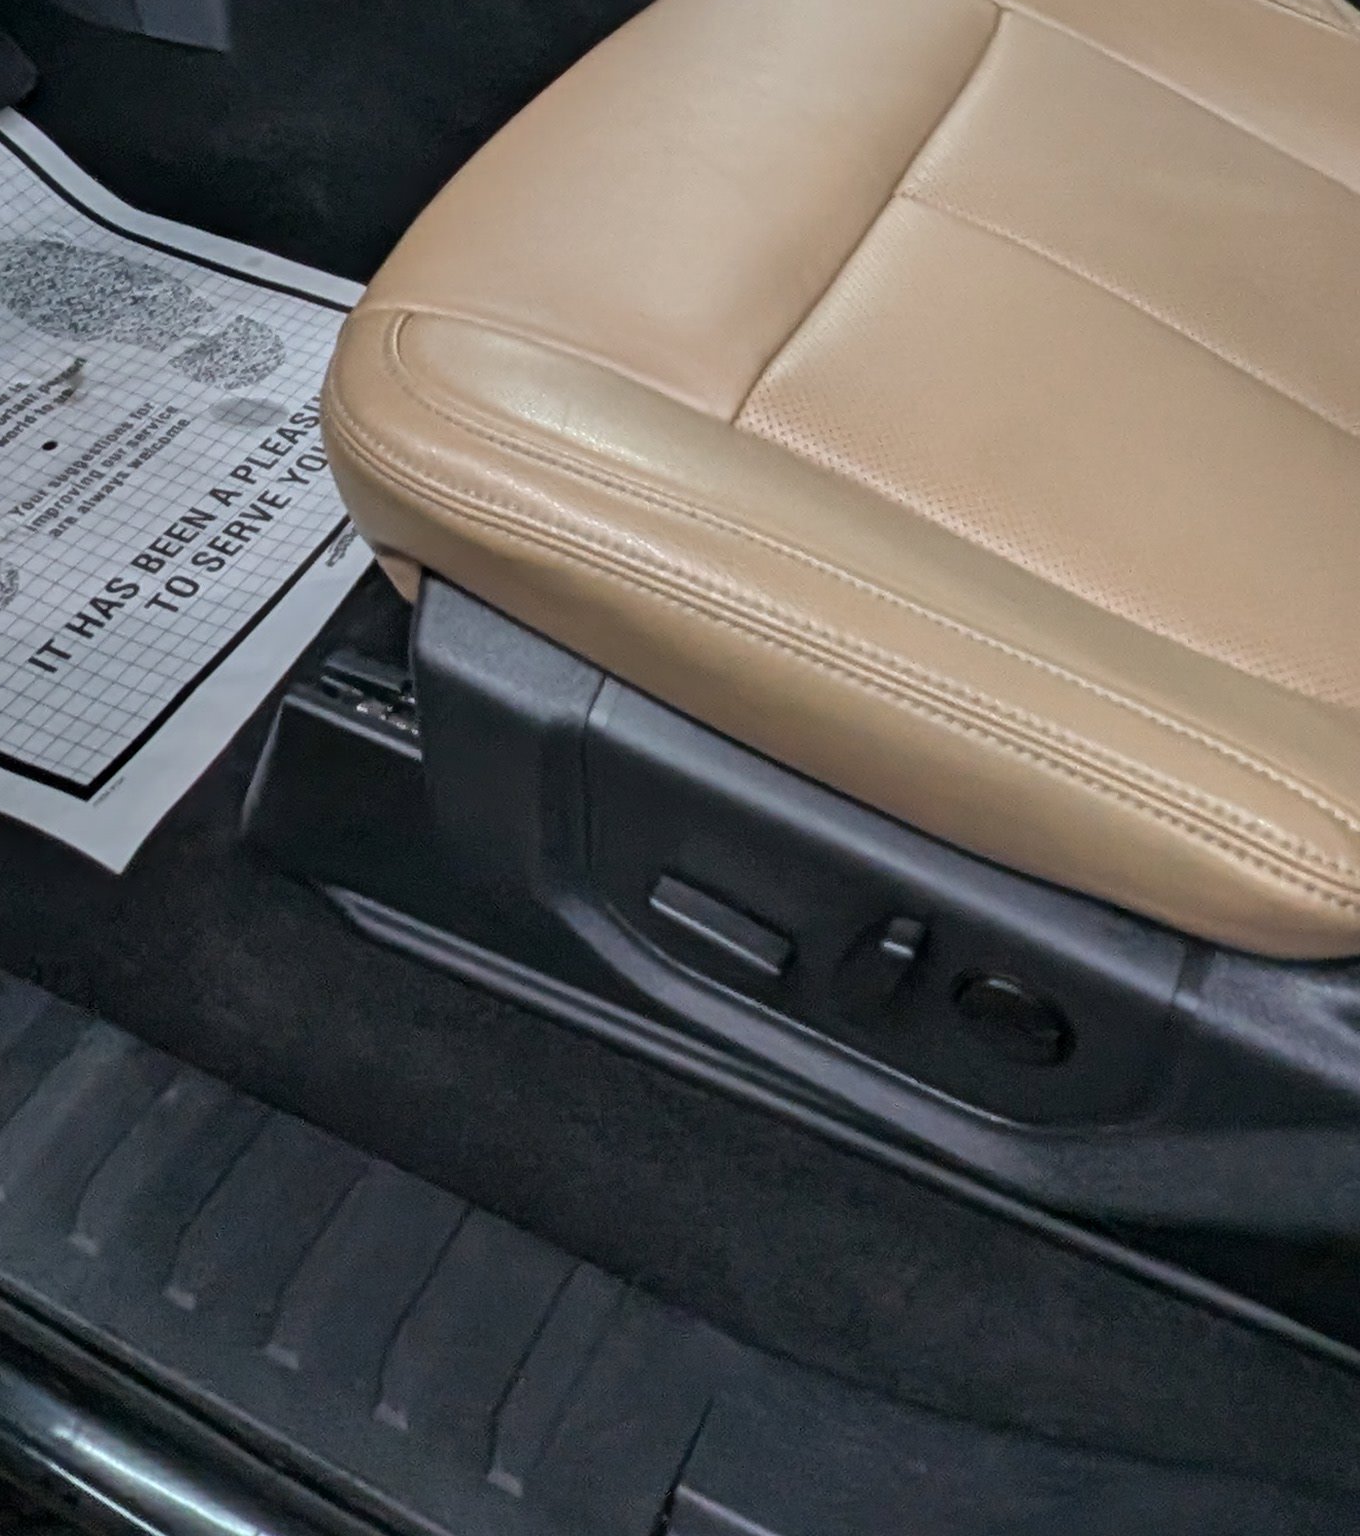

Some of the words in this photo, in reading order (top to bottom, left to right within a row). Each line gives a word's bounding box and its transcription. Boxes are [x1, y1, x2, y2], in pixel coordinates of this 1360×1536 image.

[8, 490, 49, 516] Your
[47, 421, 134, 489] suggestions
[48, 515, 79, 538] are
[76, 470, 131, 515] always
[126, 418, 191, 470] welcome
[101, 448, 128, 469] our
[126, 405, 179, 448] service
[28, 637, 72, 674] IT
[65, 576, 140, 639] HAS
[130, 507, 218, 574] BEEN
[209, 488, 243, 507] A
[144, 575, 200, 613] TO
[191, 489, 292, 573] SERVE
[276, 445, 328, 485] YO
